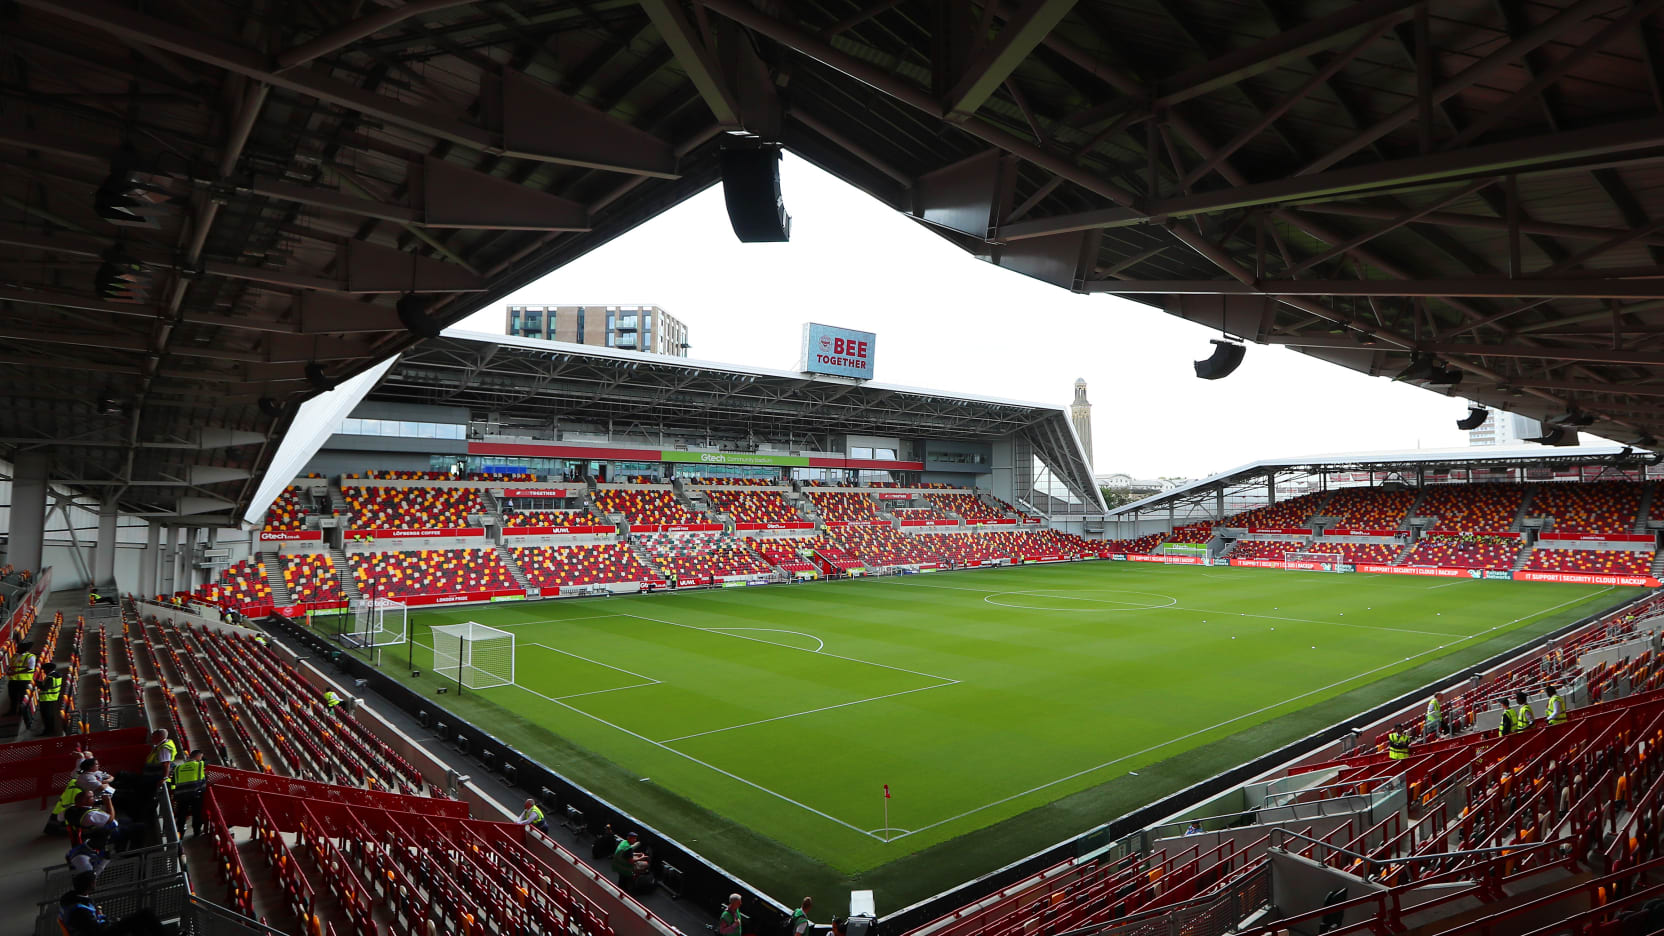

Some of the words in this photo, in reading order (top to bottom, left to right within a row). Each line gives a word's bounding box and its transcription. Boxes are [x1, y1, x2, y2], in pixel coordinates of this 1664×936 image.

[834, 337, 868, 359] BEE
[816, 354, 867, 369] TOGETHER
[701, 453, 726, 462] Gtech
[1532, 573, 1559, 581] SUPPORT
[1562, 575, 1591, 583] SECURITY
[1595, 576, 1616, 584] CLOUD
